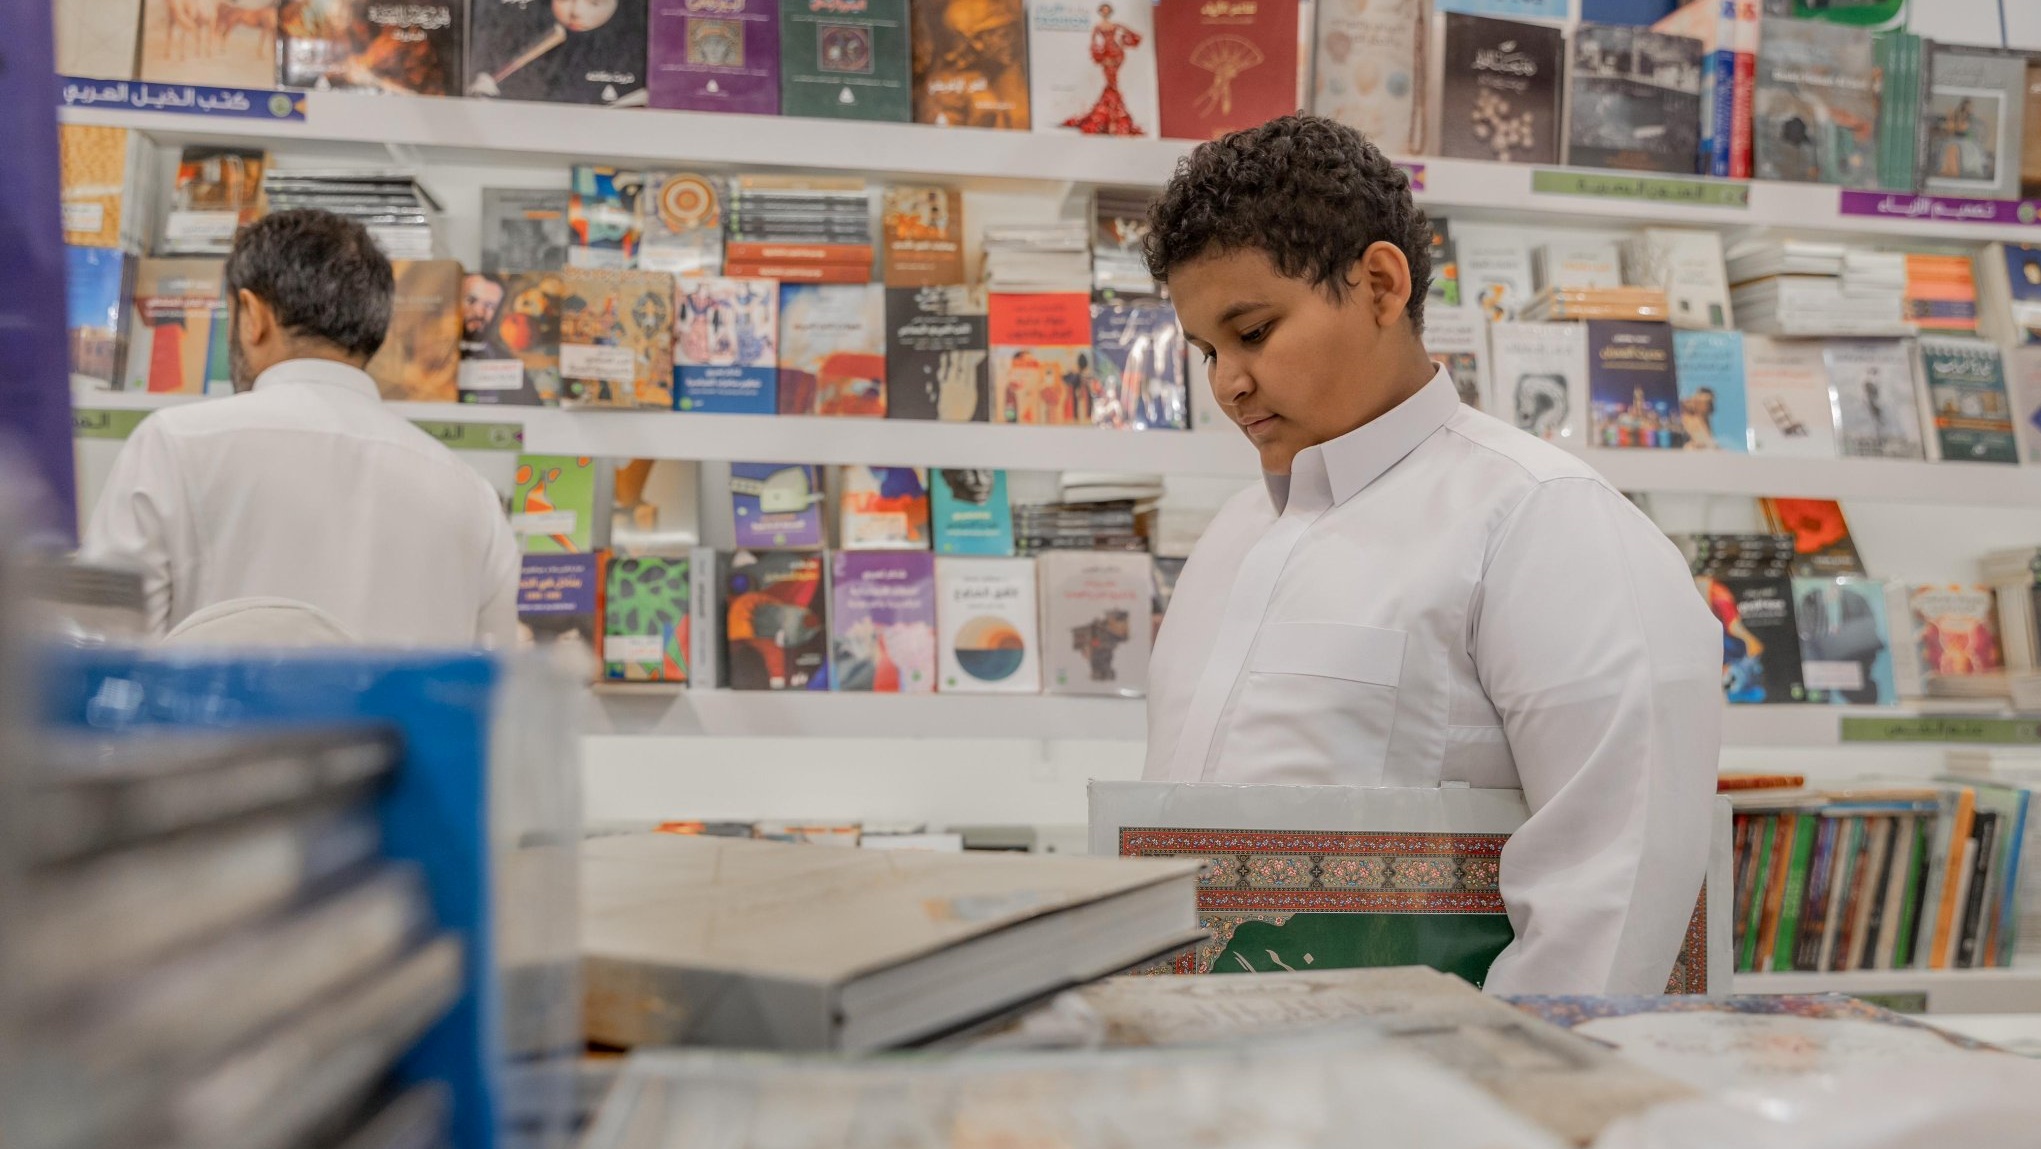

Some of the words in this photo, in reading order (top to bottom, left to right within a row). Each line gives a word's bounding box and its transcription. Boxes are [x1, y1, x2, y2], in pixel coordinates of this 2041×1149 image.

[63, 82, 129, 106] العربي
[131, 83, 195, 109] الخيل
[196, 91, 250, 112] كتب
[1930, 201, 1996, 221] تصميم
